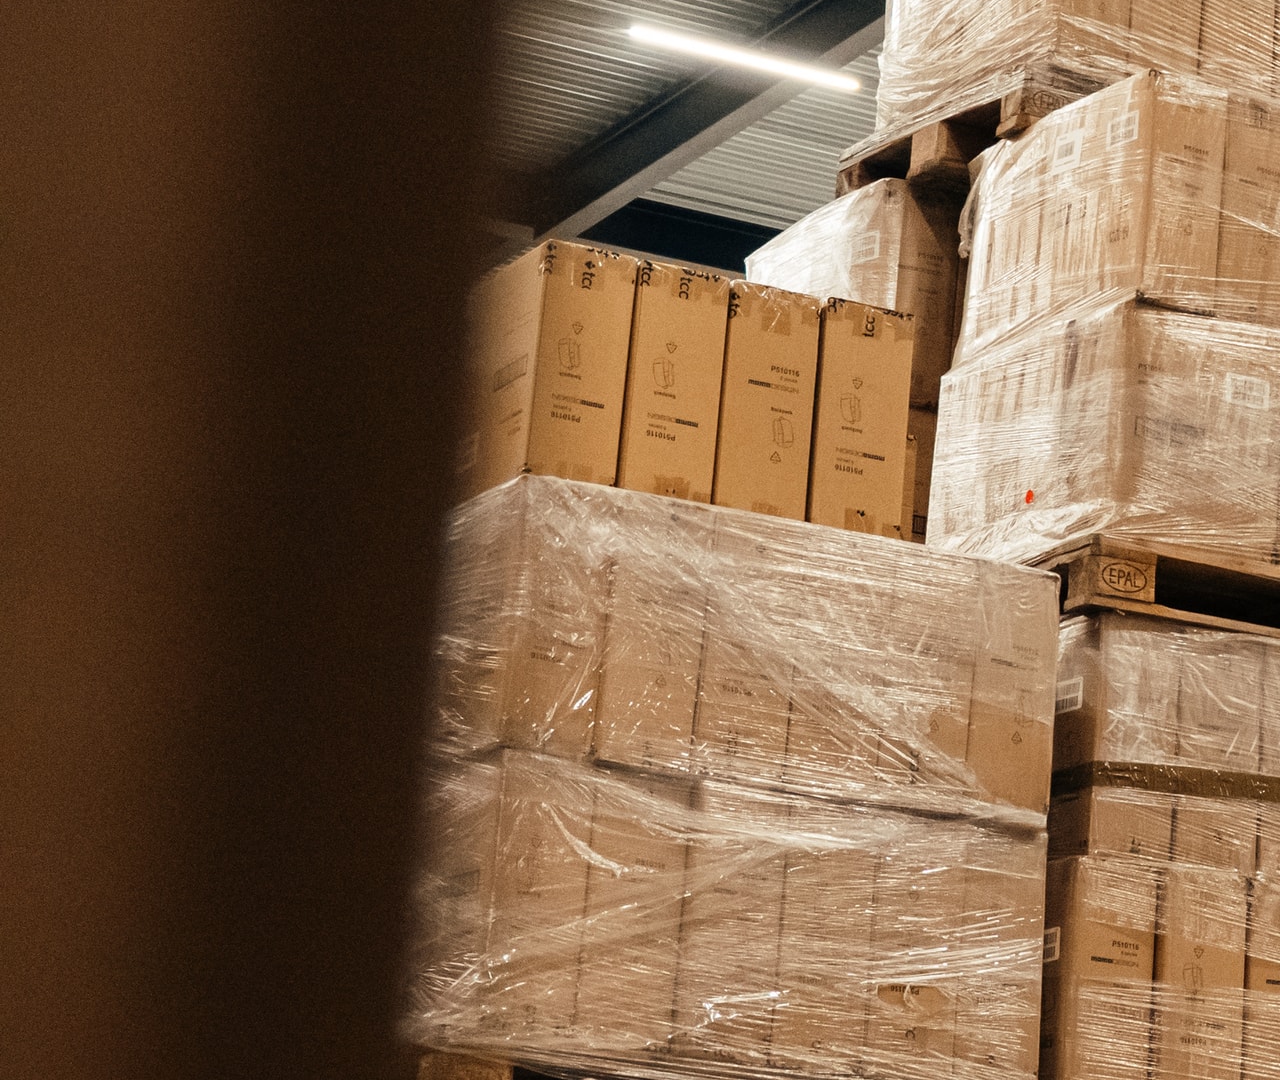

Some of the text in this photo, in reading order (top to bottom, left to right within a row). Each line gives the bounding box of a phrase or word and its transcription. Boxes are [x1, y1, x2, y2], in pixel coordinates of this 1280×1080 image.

[771, 364, 800, 377] P510116
[646, 429, 676, 442] P510116
[835, 463, 864, 476] P510116
[1108, 567, 1141, 589] EPAL
[1112, 940, 1140, 951] P510116
